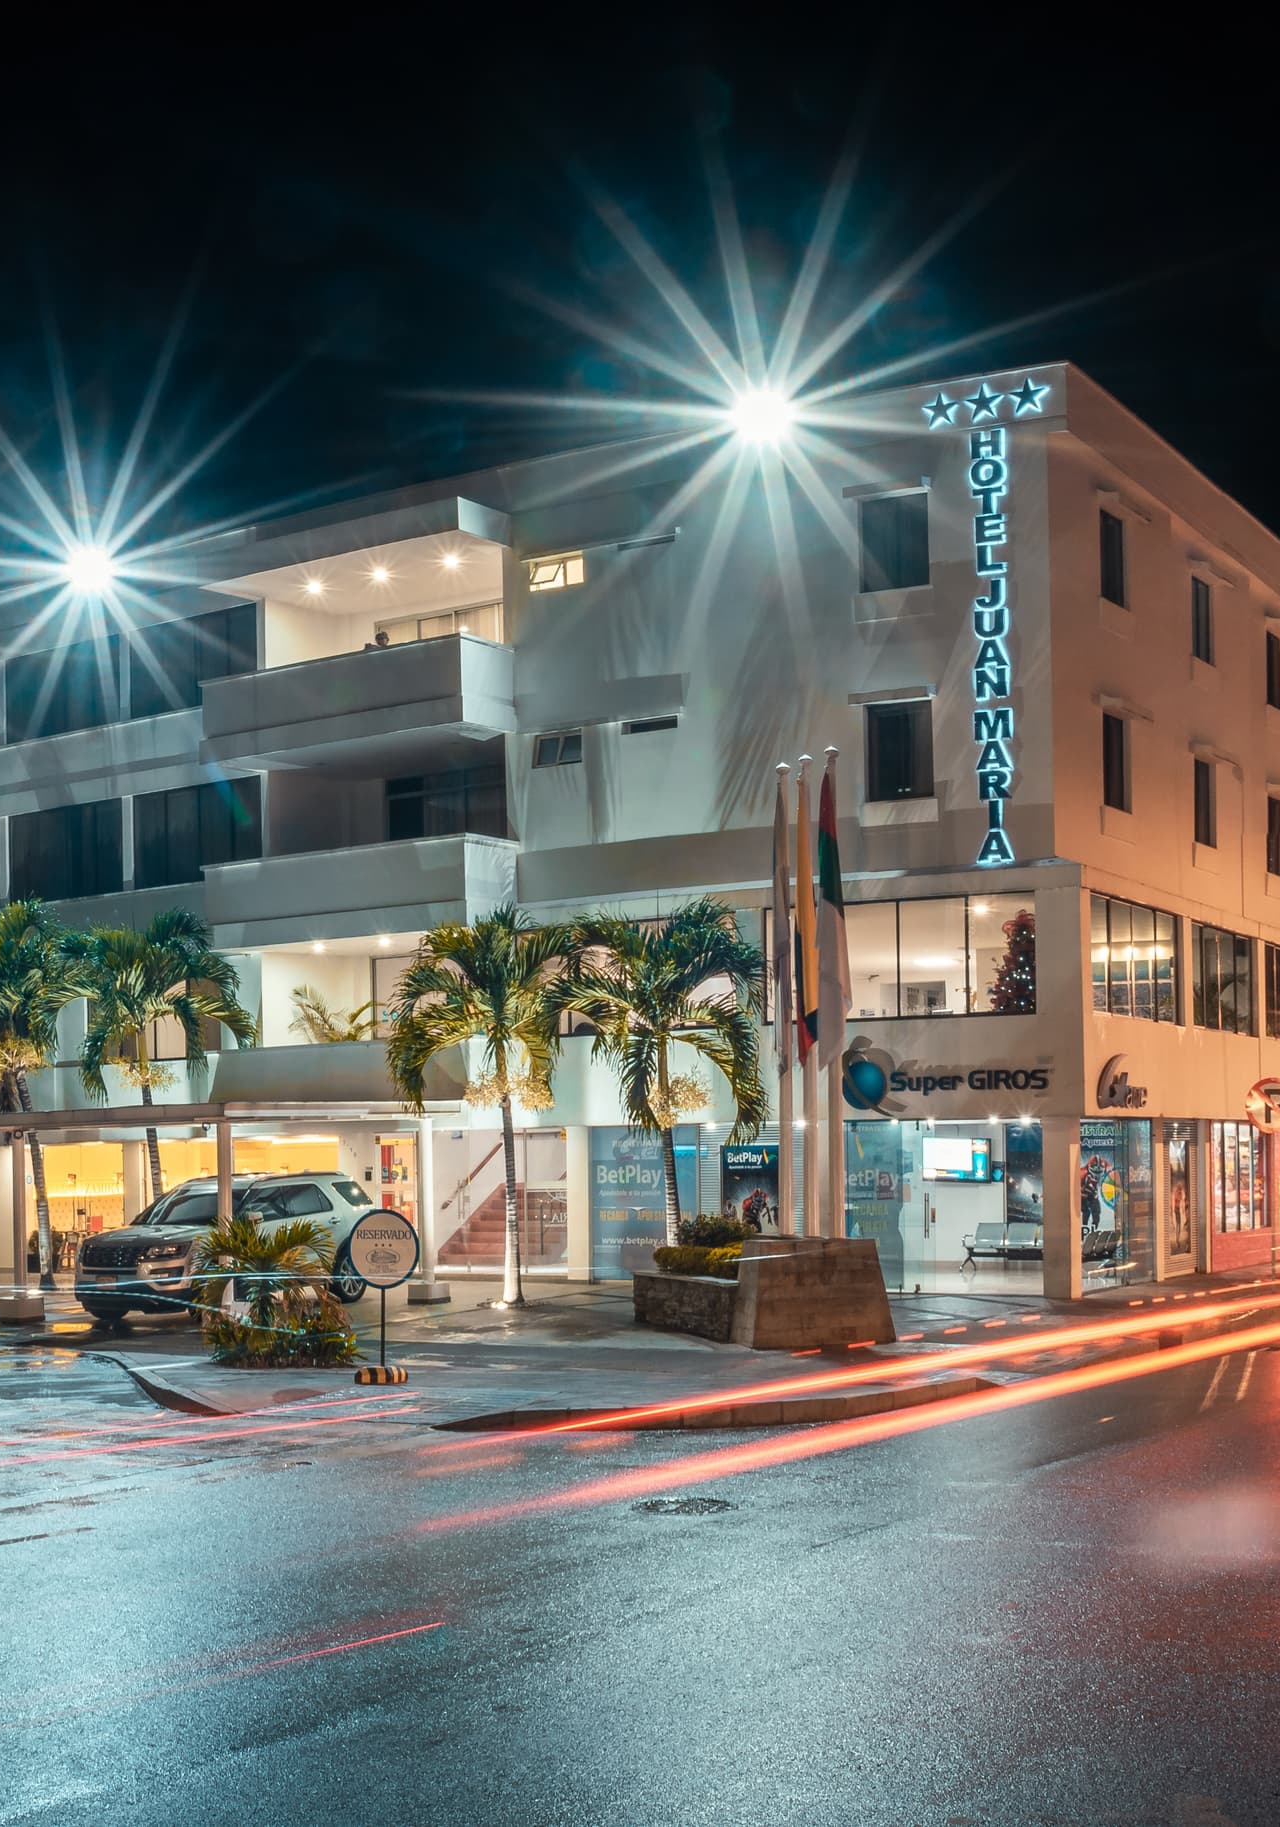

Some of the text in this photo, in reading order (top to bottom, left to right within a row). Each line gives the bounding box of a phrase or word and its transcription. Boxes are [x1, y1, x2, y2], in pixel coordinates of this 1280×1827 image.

[969, 428, 1016, 865] HOTEL JUAN MARIA
[889, 1068, 1050, 1097] Super GIROS
[727, 1150, 763, 1165] BetPlay
[596, 1163, 662, 1189] BetPlay
[356, 1228, 413, 1240] RESERVADO
